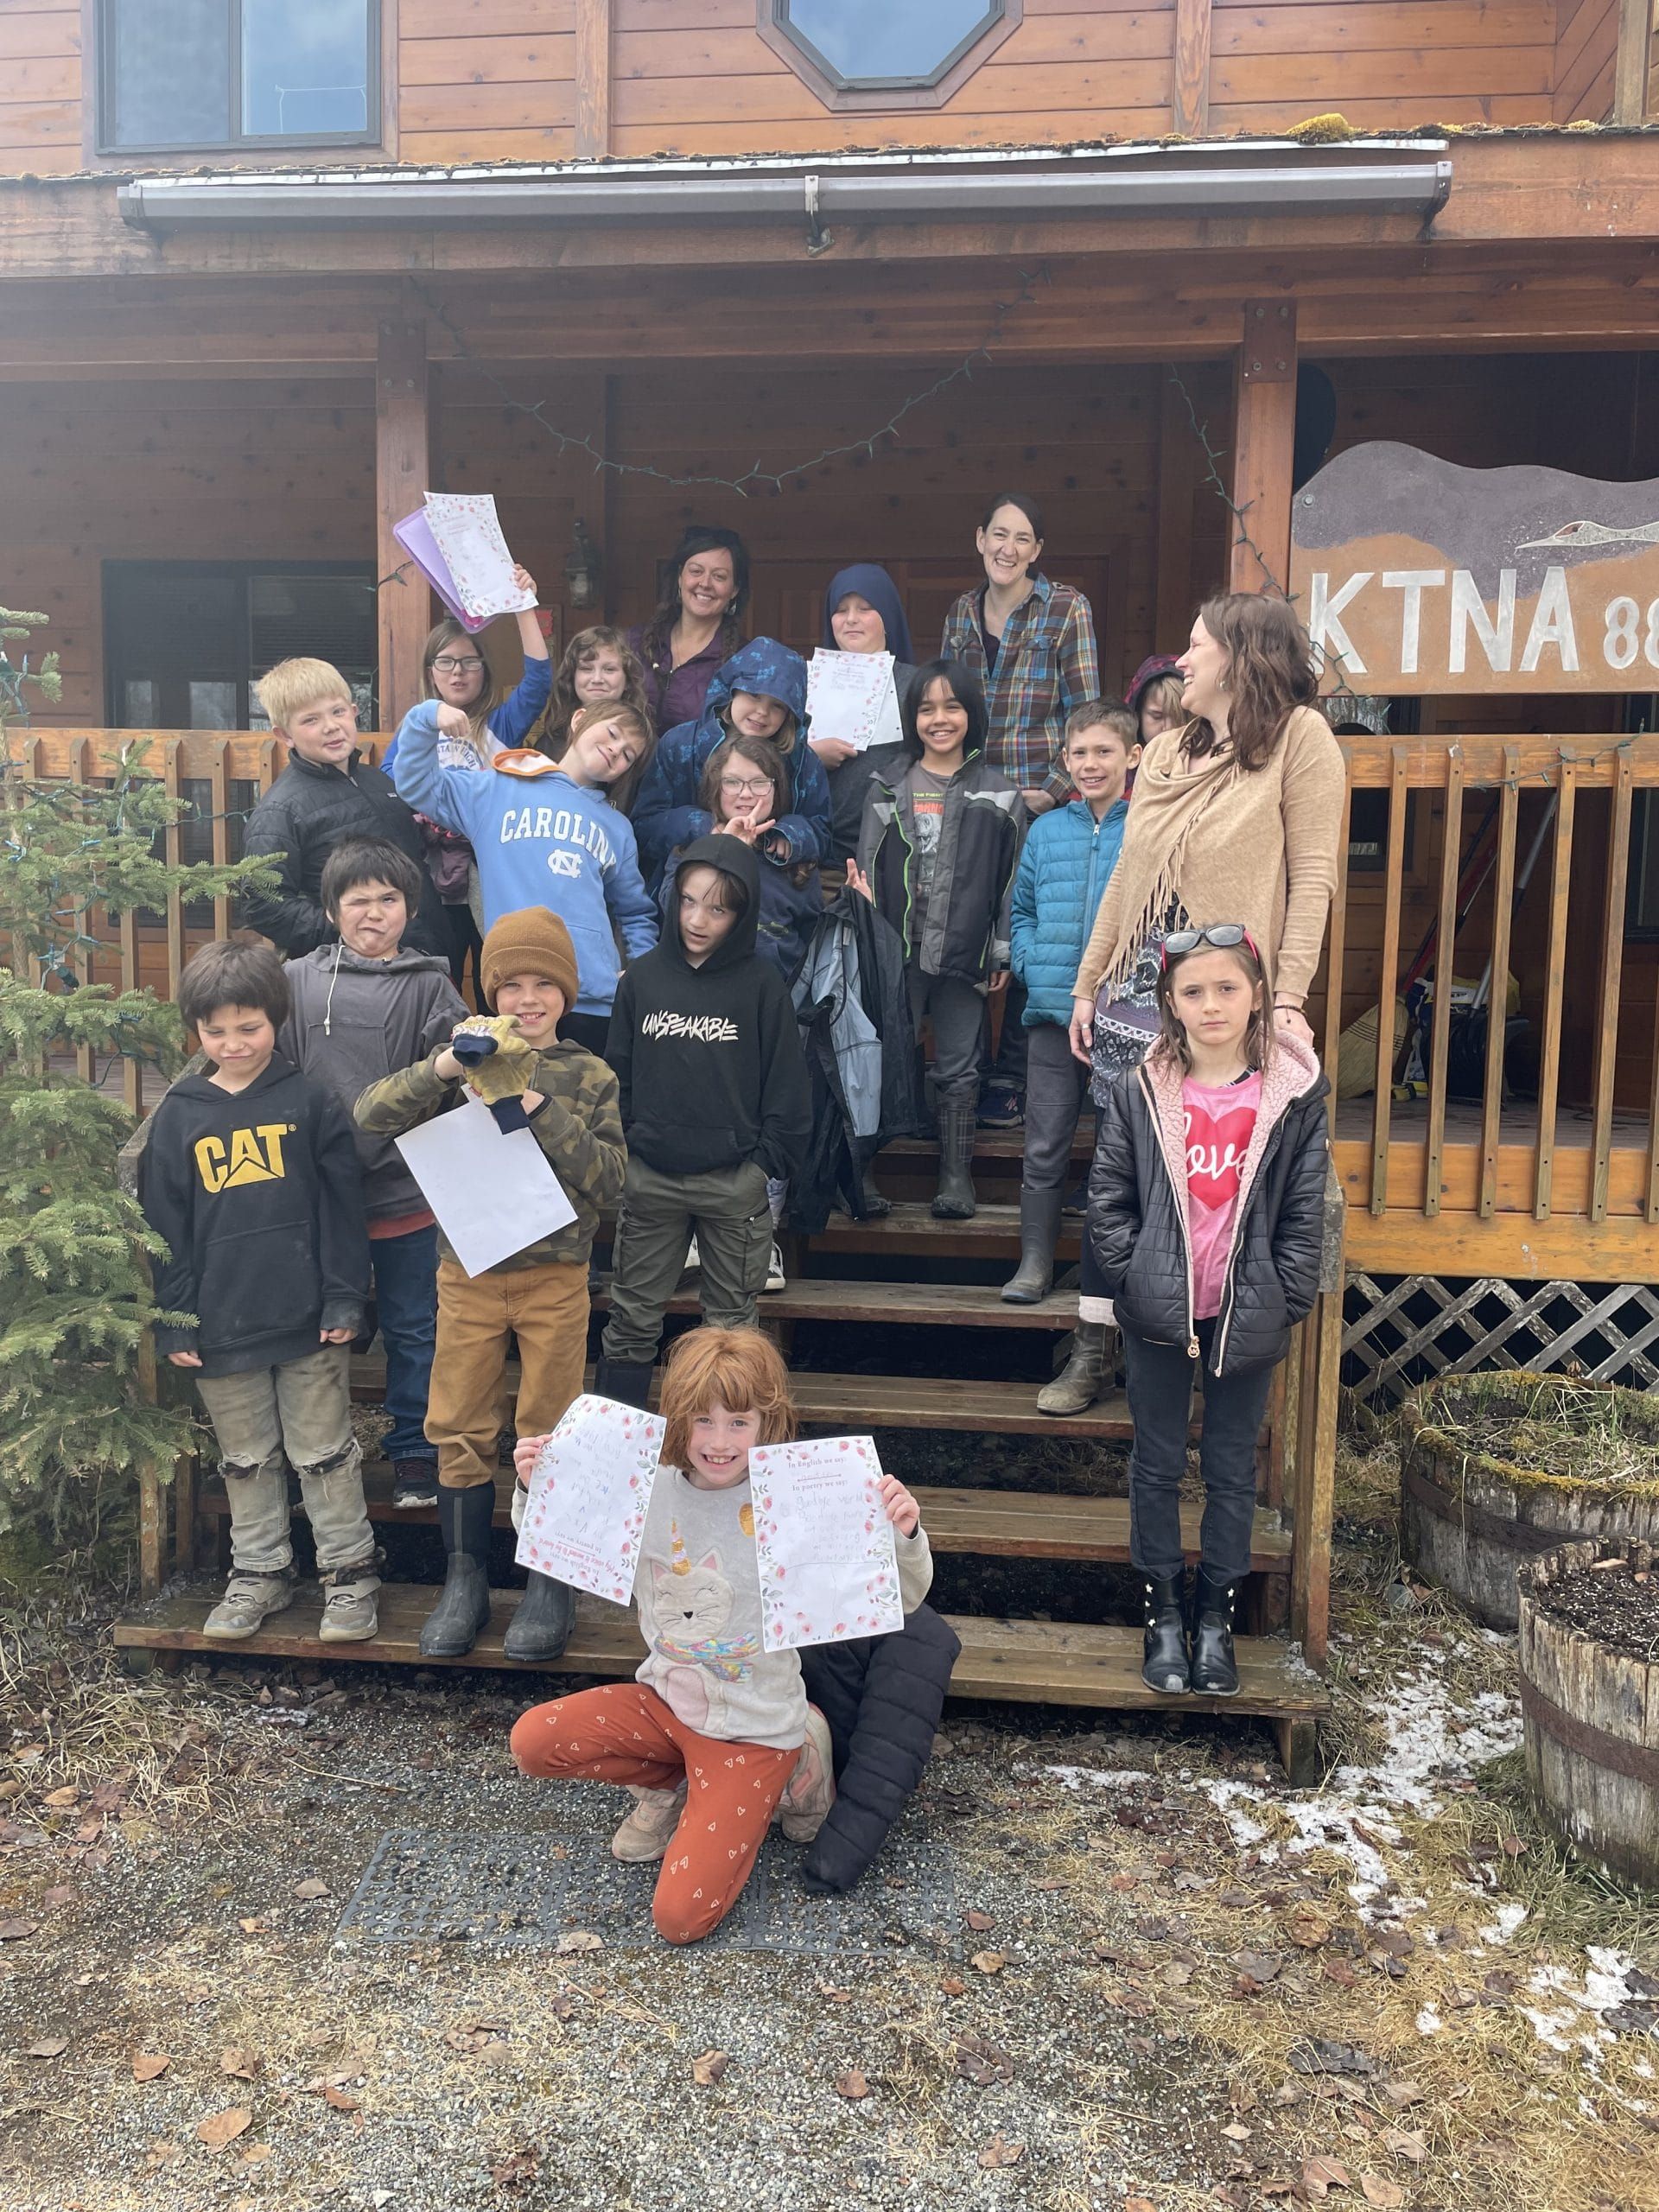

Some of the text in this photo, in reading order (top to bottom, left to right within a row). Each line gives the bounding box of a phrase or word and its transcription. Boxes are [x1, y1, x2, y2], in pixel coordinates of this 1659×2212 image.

[1310, 566, 1580, 674] KTNA
[642, 1009, 739, 1043] UNSPEAKABLE
[798, 1459, 822, 1468] English
[802, 1483, 823, 1491] poetry
